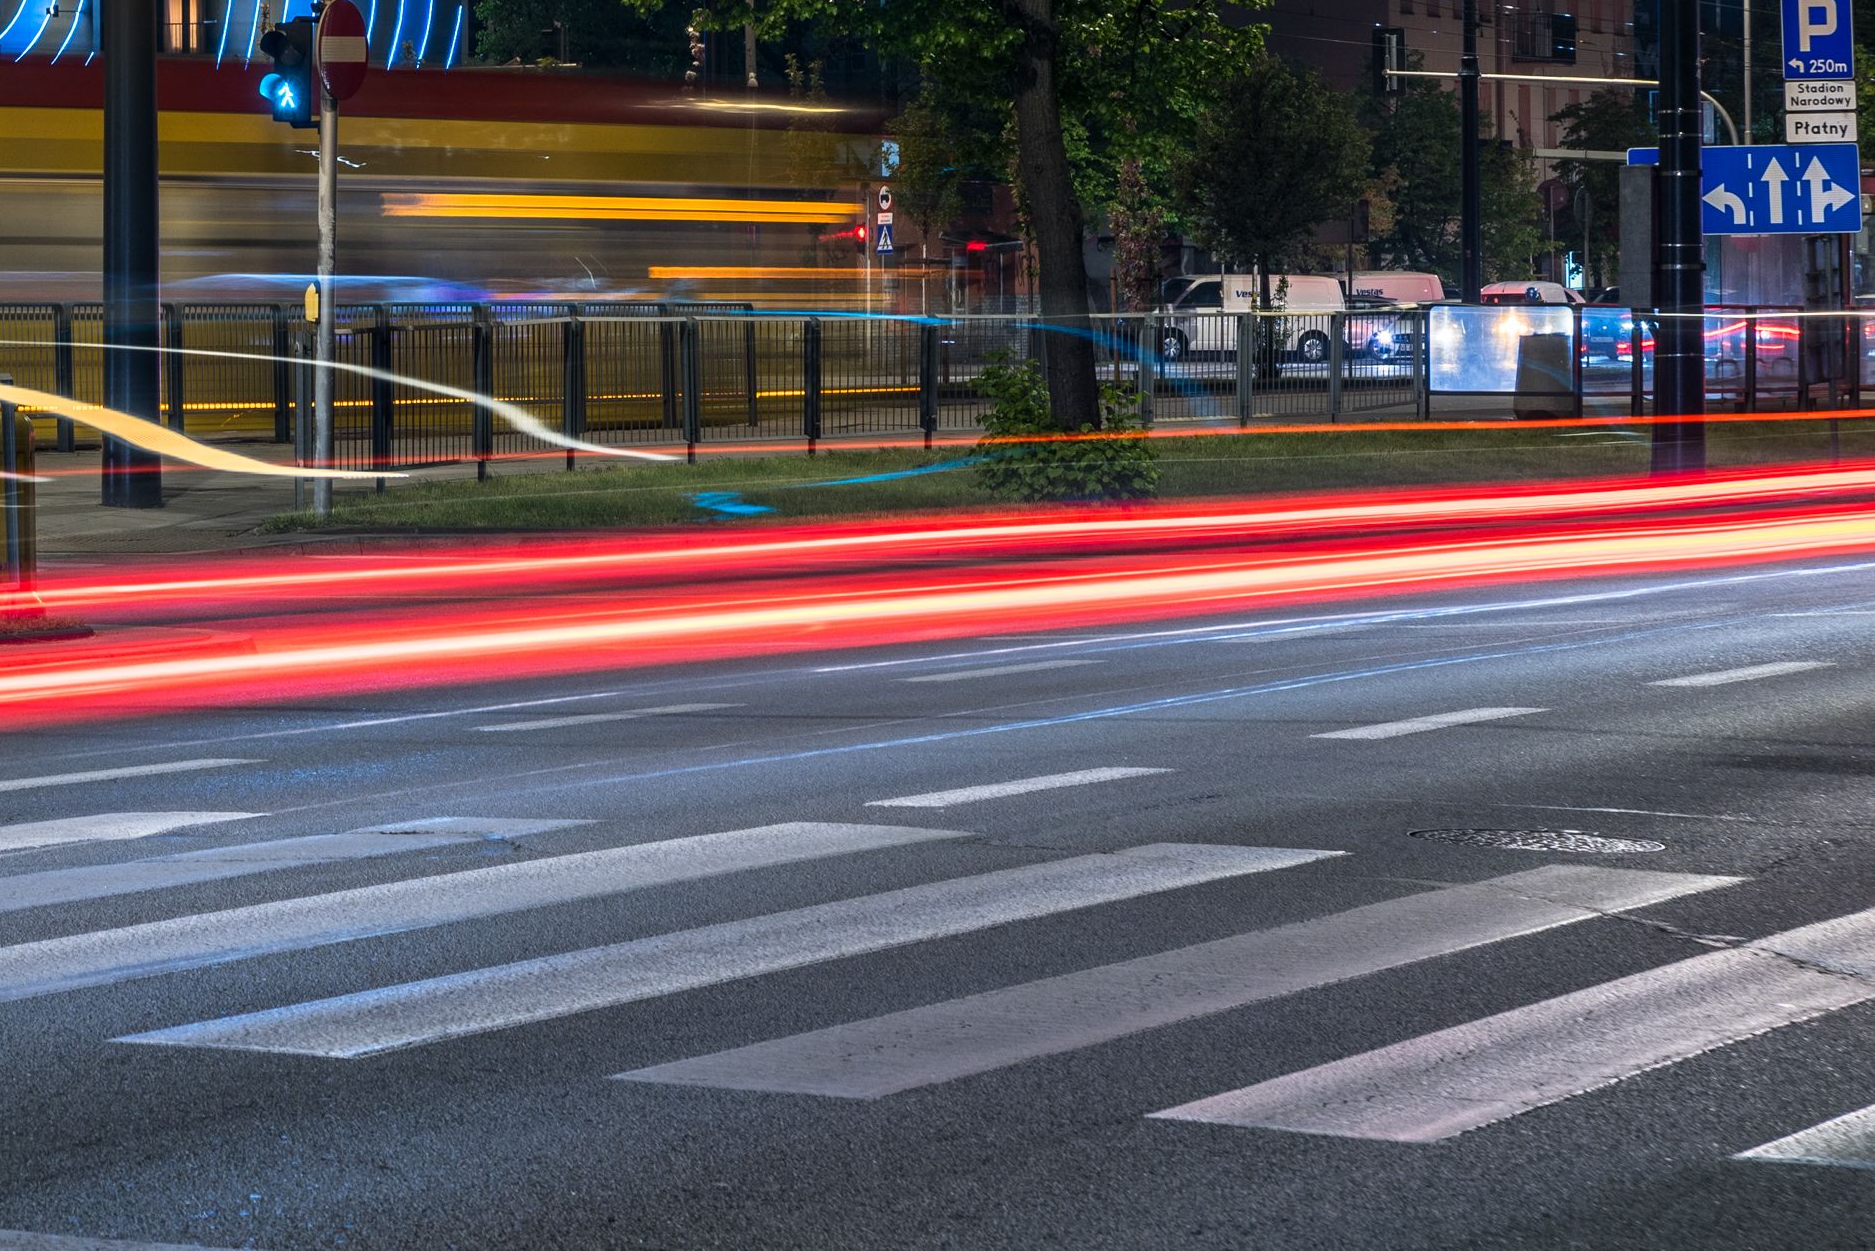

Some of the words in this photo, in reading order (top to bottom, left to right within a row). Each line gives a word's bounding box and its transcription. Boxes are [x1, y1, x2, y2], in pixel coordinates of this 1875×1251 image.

[1809, 59, 1847, 73] 250m
[1797, 83, 1844, 93] Stadion
[1790, 95, 1851, 107] Narodowy
[1794, 121, 1848, 138] Płatny
[1356, 288, 1383, 296] Vestas
